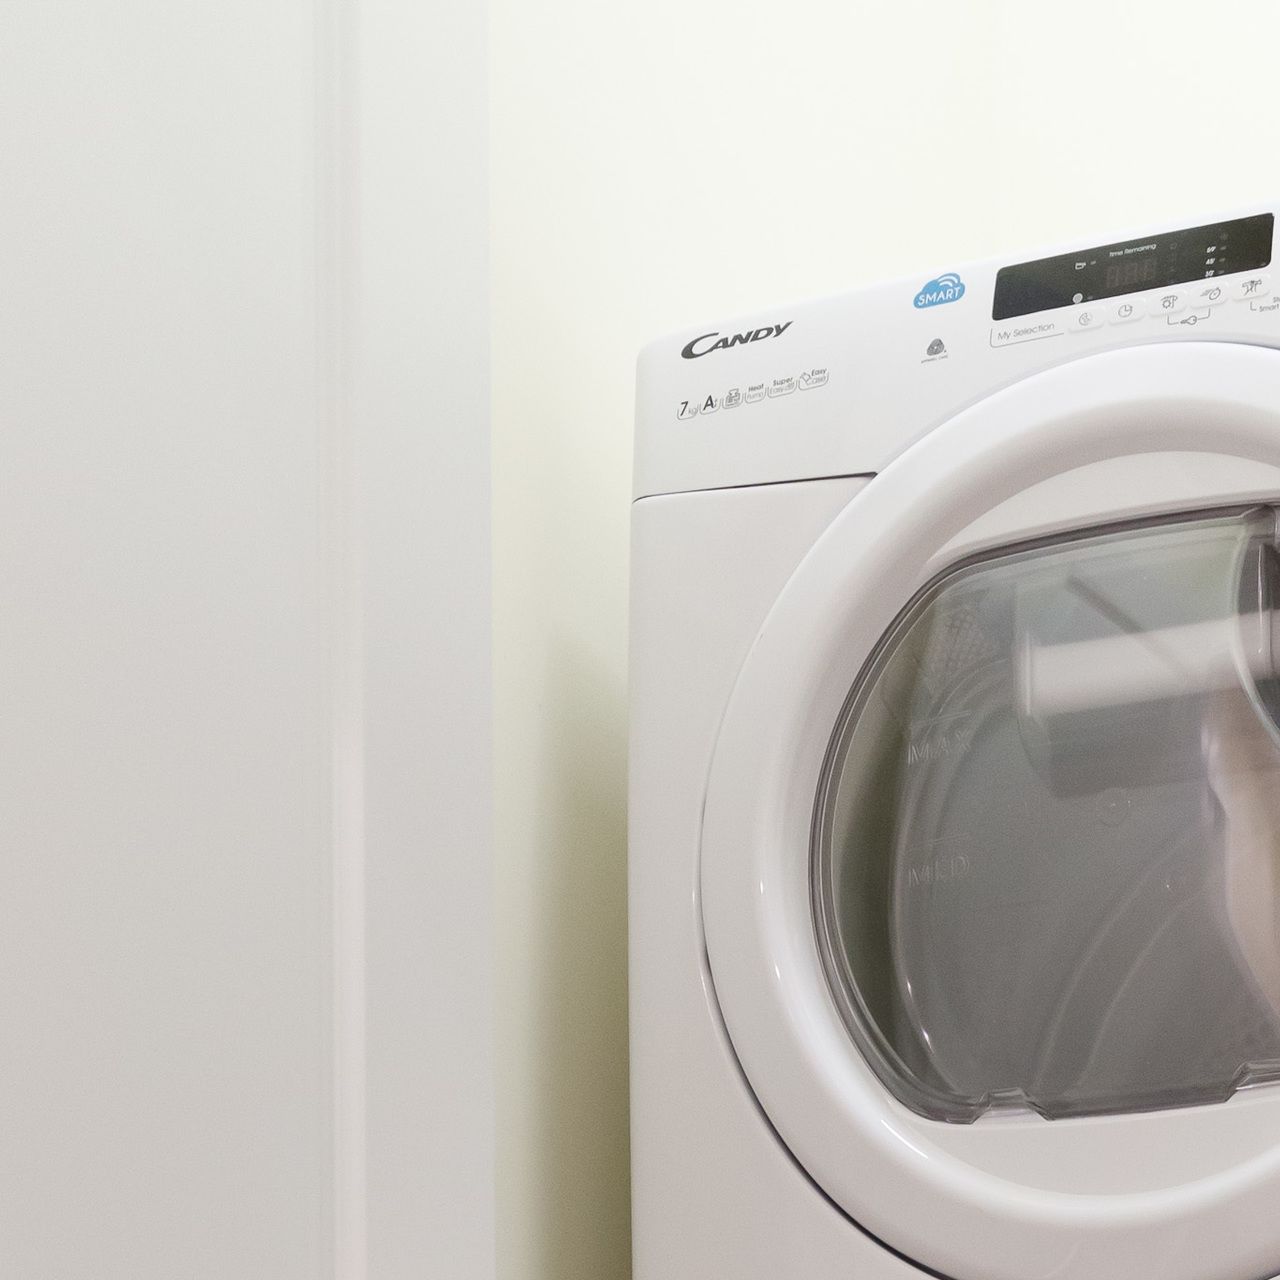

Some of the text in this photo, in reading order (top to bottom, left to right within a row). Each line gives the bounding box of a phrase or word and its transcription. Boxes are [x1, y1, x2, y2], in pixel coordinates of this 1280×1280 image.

[918, 286, 961, 306] SMART
[1260, 303, 1279, 312] Smart
[680, 320, 794, 360] CANDY
[998, 323, 1055, 340] My Selection
[811, 368, 827, 377] Easy
[773, 377, 793, 387] Super
[907, 730, 971, 765] MAX
